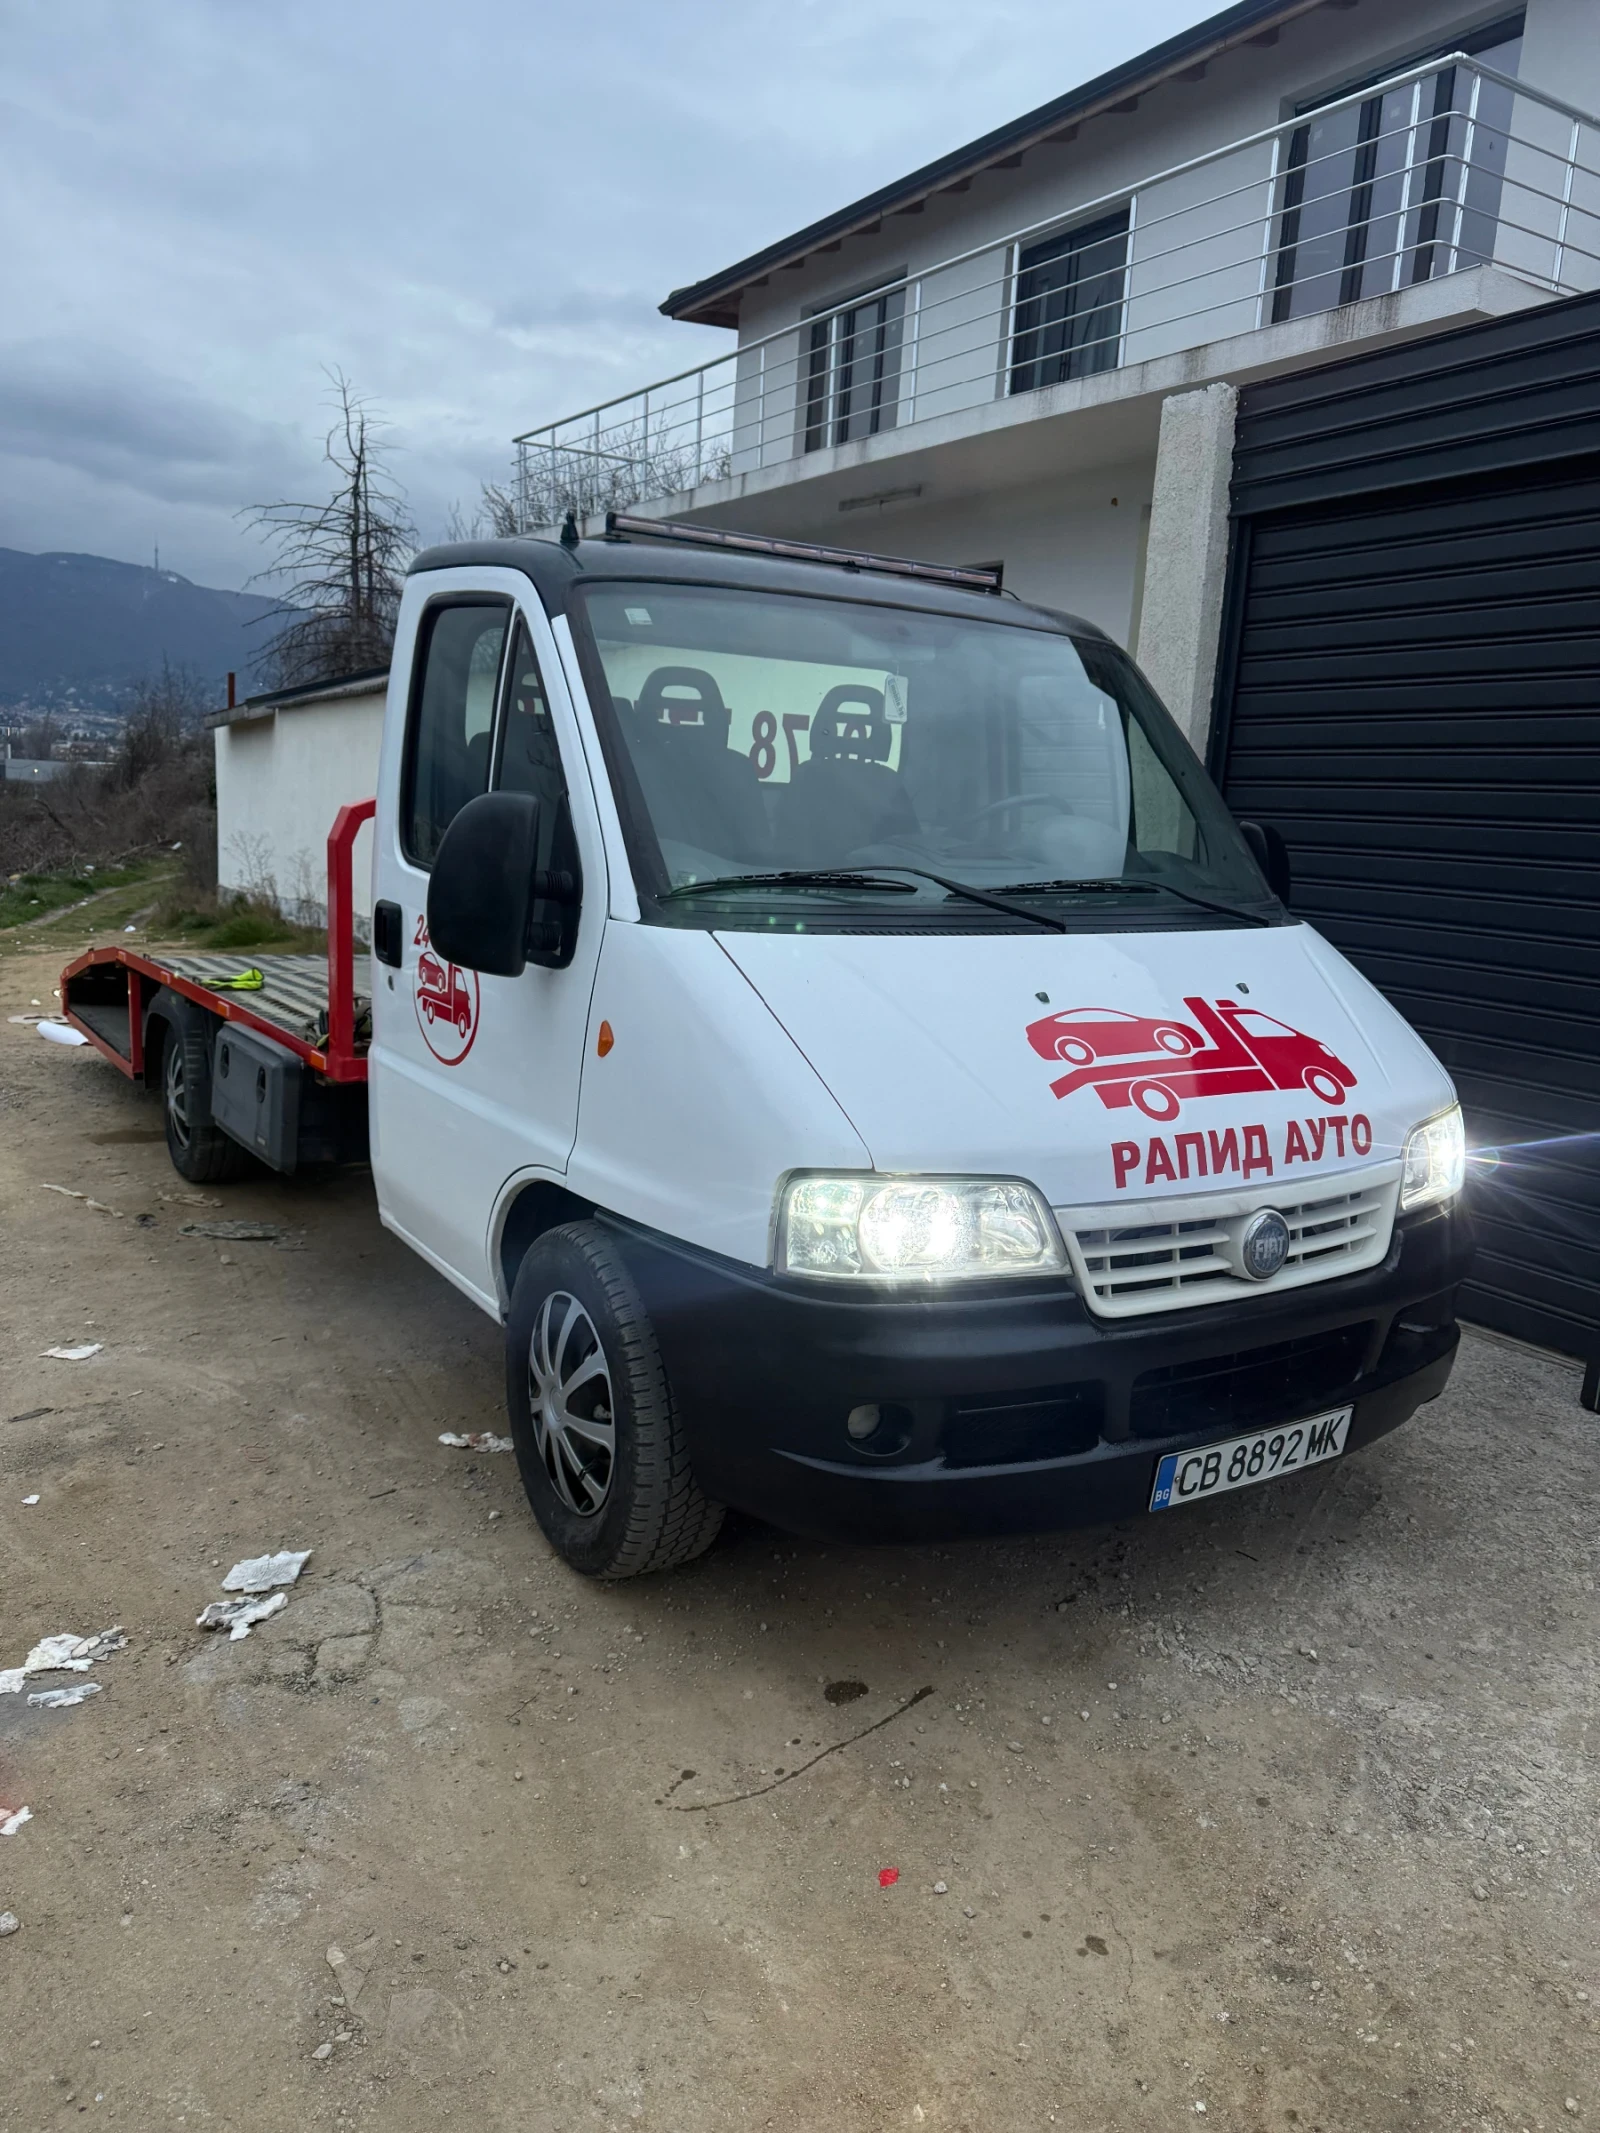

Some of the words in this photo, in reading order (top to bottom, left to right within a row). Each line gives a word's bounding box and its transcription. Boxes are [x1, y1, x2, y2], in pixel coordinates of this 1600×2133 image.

[1111, 1124, 1273, 1189] РАПИД
[1284, 1113, 1373, 1164] АУТО
[1254, 1235, 1285, 1261] FIAT
[1178, 1451, 1222, 1496] CB
[1227, 1429, 1304, 1483] 8892
[1304, 1415, 1345, 1461] MK
[1154, 1488, 1170, 1502] BG
